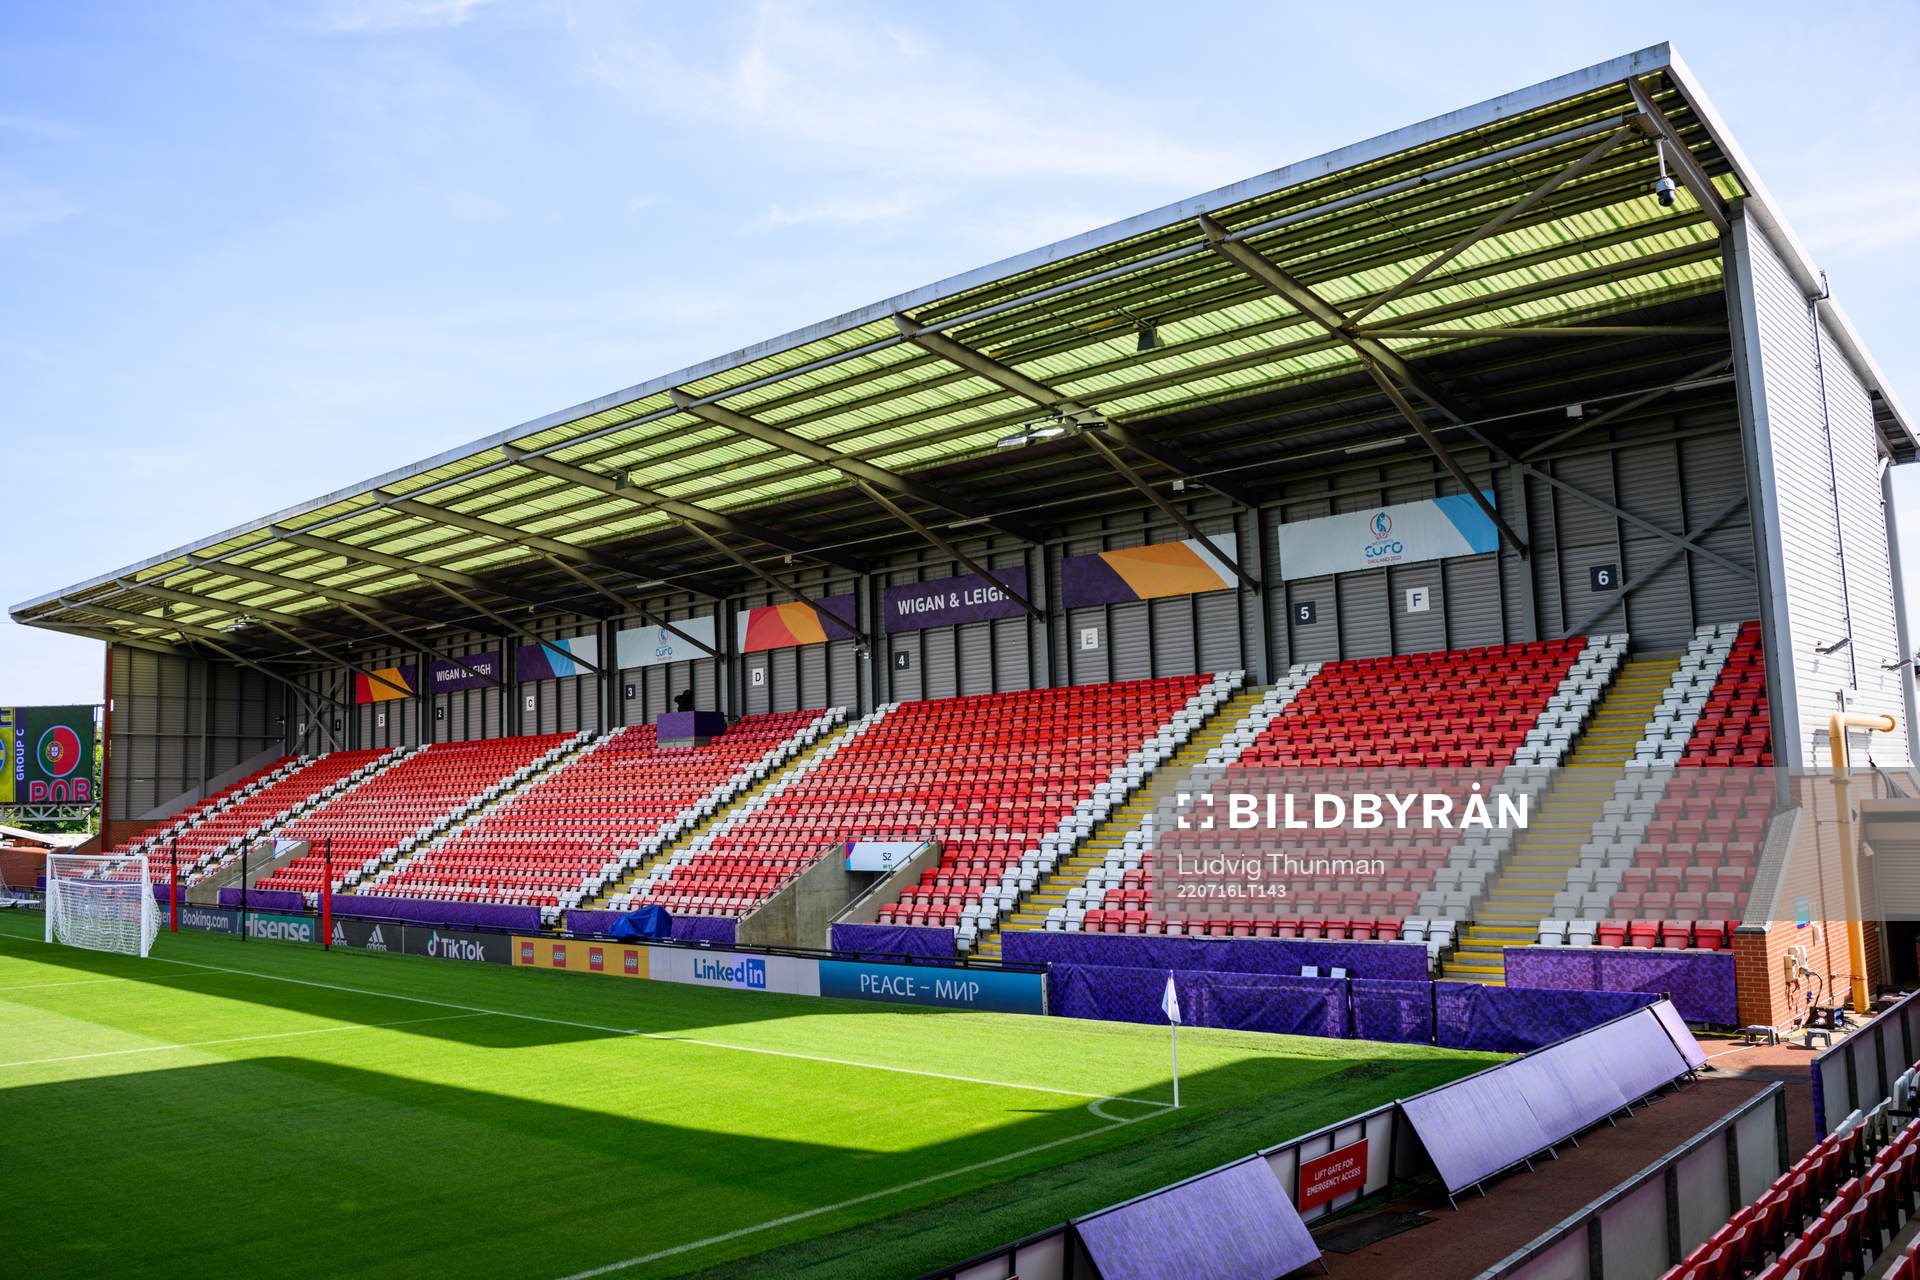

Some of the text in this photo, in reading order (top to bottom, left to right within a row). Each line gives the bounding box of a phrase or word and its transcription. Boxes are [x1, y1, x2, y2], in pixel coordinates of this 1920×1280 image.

[1598, 571, 1609, 585] 6
[897, 594, 945, 615] WIGAN
[949, 592, 960, 608] &
[1413, 593, 1422, 607] F
[1300, 607, 1309, 620] 5
[1085, 633, 1094, 645] E
[898, 655, 905, 666] 4
[436, 668, 460, 682] WIGAN
[461, 670, 467, 678] &
[755, 672, 761, 682] D
[627, 687, 633, 697] 3
[528, 699, 533, 708] C
[438, 709, 442, 718] 2
[16, 728, 25, 781] GROUP C
[29, 777, 91, 802] POR
[882, 852, 892, 861] S2
[182, 909, 229, 930] Booking.com
[245, 912, 310, 942] Hisense
[441, 937, 485, 961] TikTok
[554, 952, 565, 960] LEGO
[591, 954, 603, 963] LEGO
[625, 957, 638, 967] LEGO
[860, 974, 915, 996] PEACE
[1315, 1158, 1354, 1180] LIFT GATE FOR
[1306, 1166, 1361, 1196] EMERGENCY ACCESS
